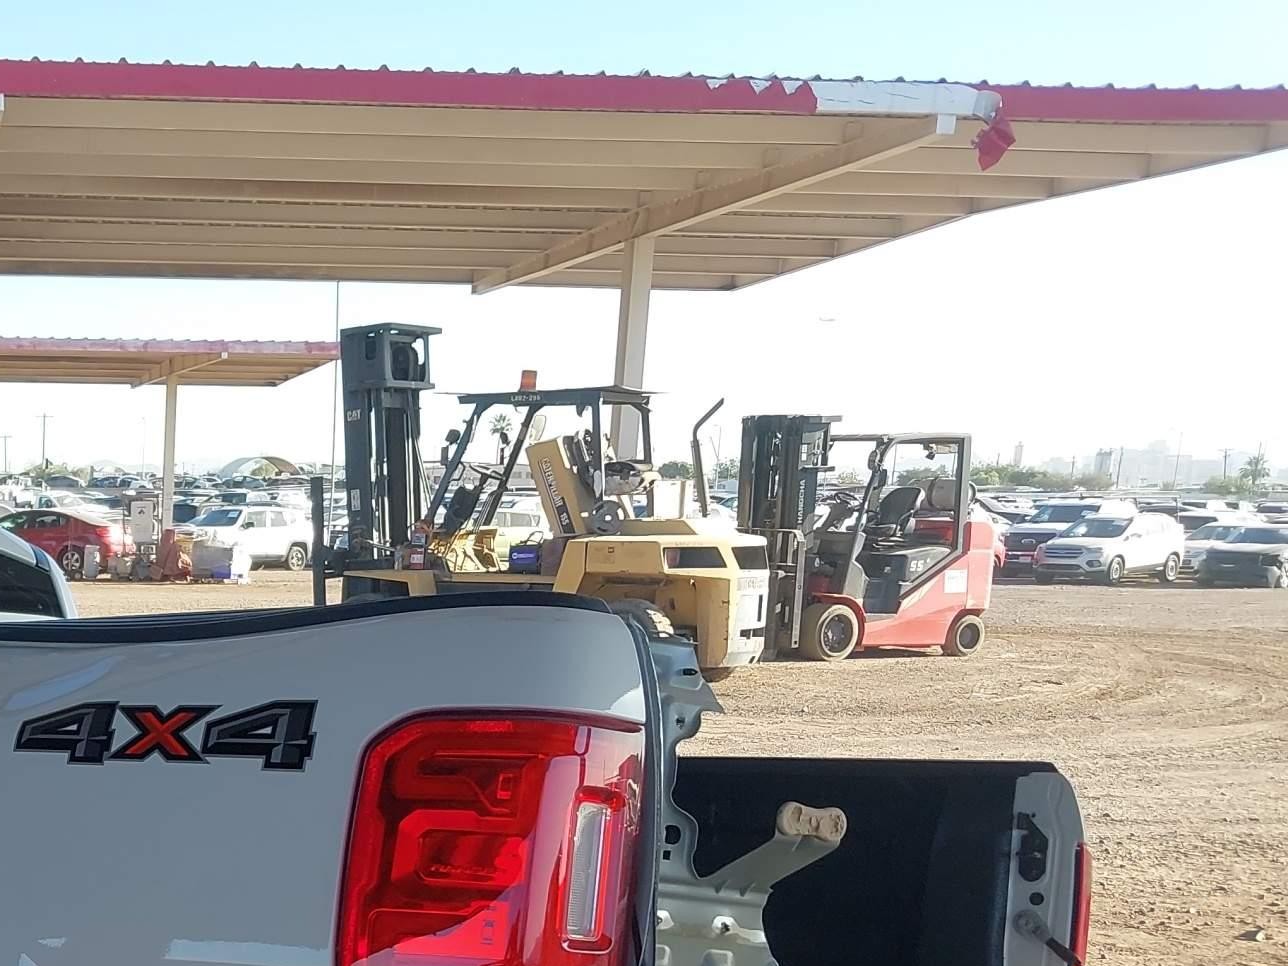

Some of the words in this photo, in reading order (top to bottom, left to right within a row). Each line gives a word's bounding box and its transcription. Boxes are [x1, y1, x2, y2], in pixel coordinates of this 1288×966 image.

[346, 409, 360, 422] CAT
[797, 480, 806, 524] HANGCHA
[560, 512, 570, 526] 155
[13, 699, 318, 772] 4X4
